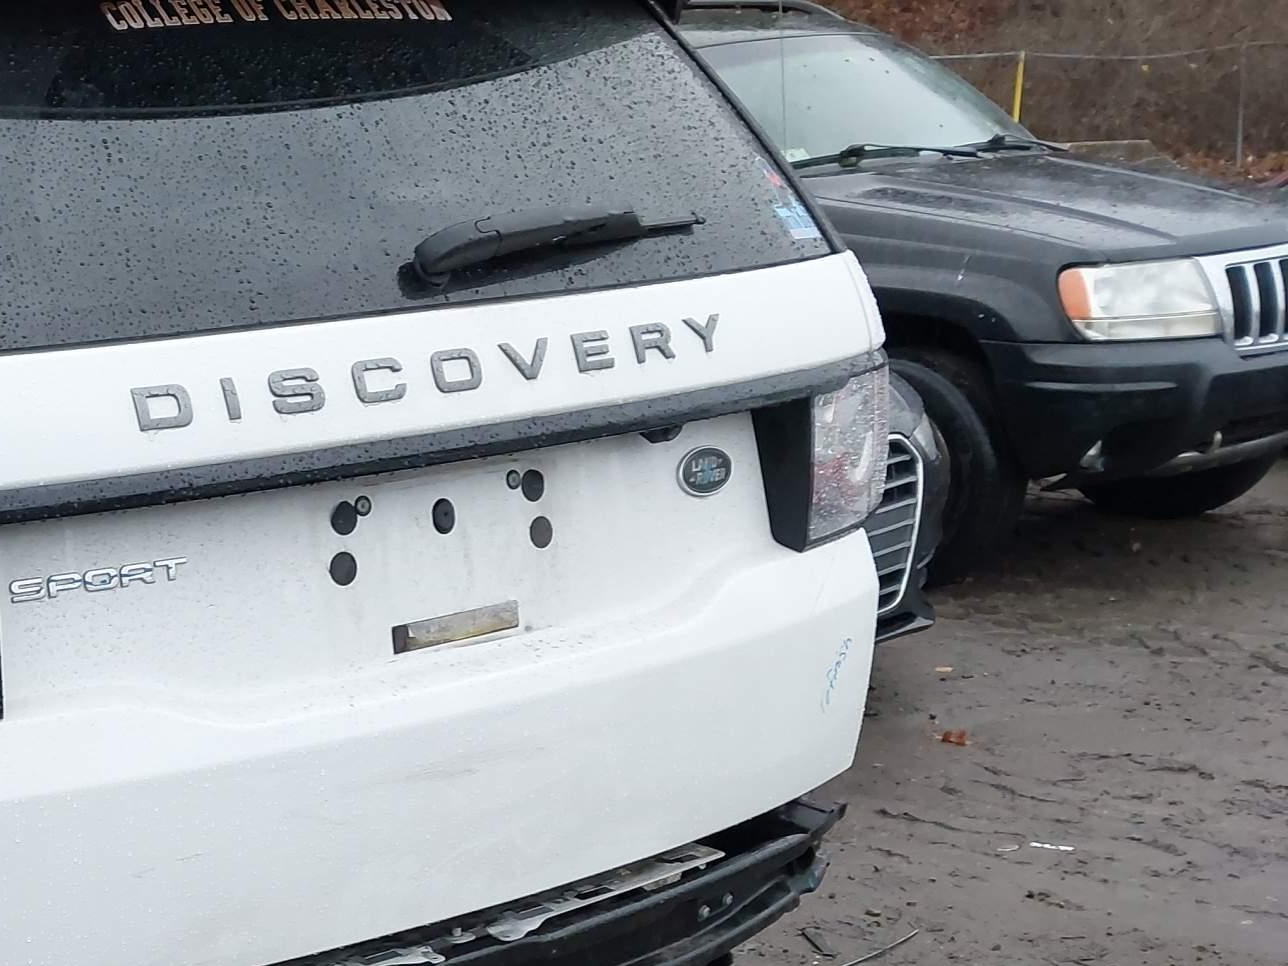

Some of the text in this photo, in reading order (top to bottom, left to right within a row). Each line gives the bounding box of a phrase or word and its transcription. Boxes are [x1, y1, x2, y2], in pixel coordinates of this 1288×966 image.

[101, 0, 454, 30] COLLEGE OF CHARLESTON
[130, 313, 720, 432] DISCOVERY
[9, 556, 188, 603] SPORT
